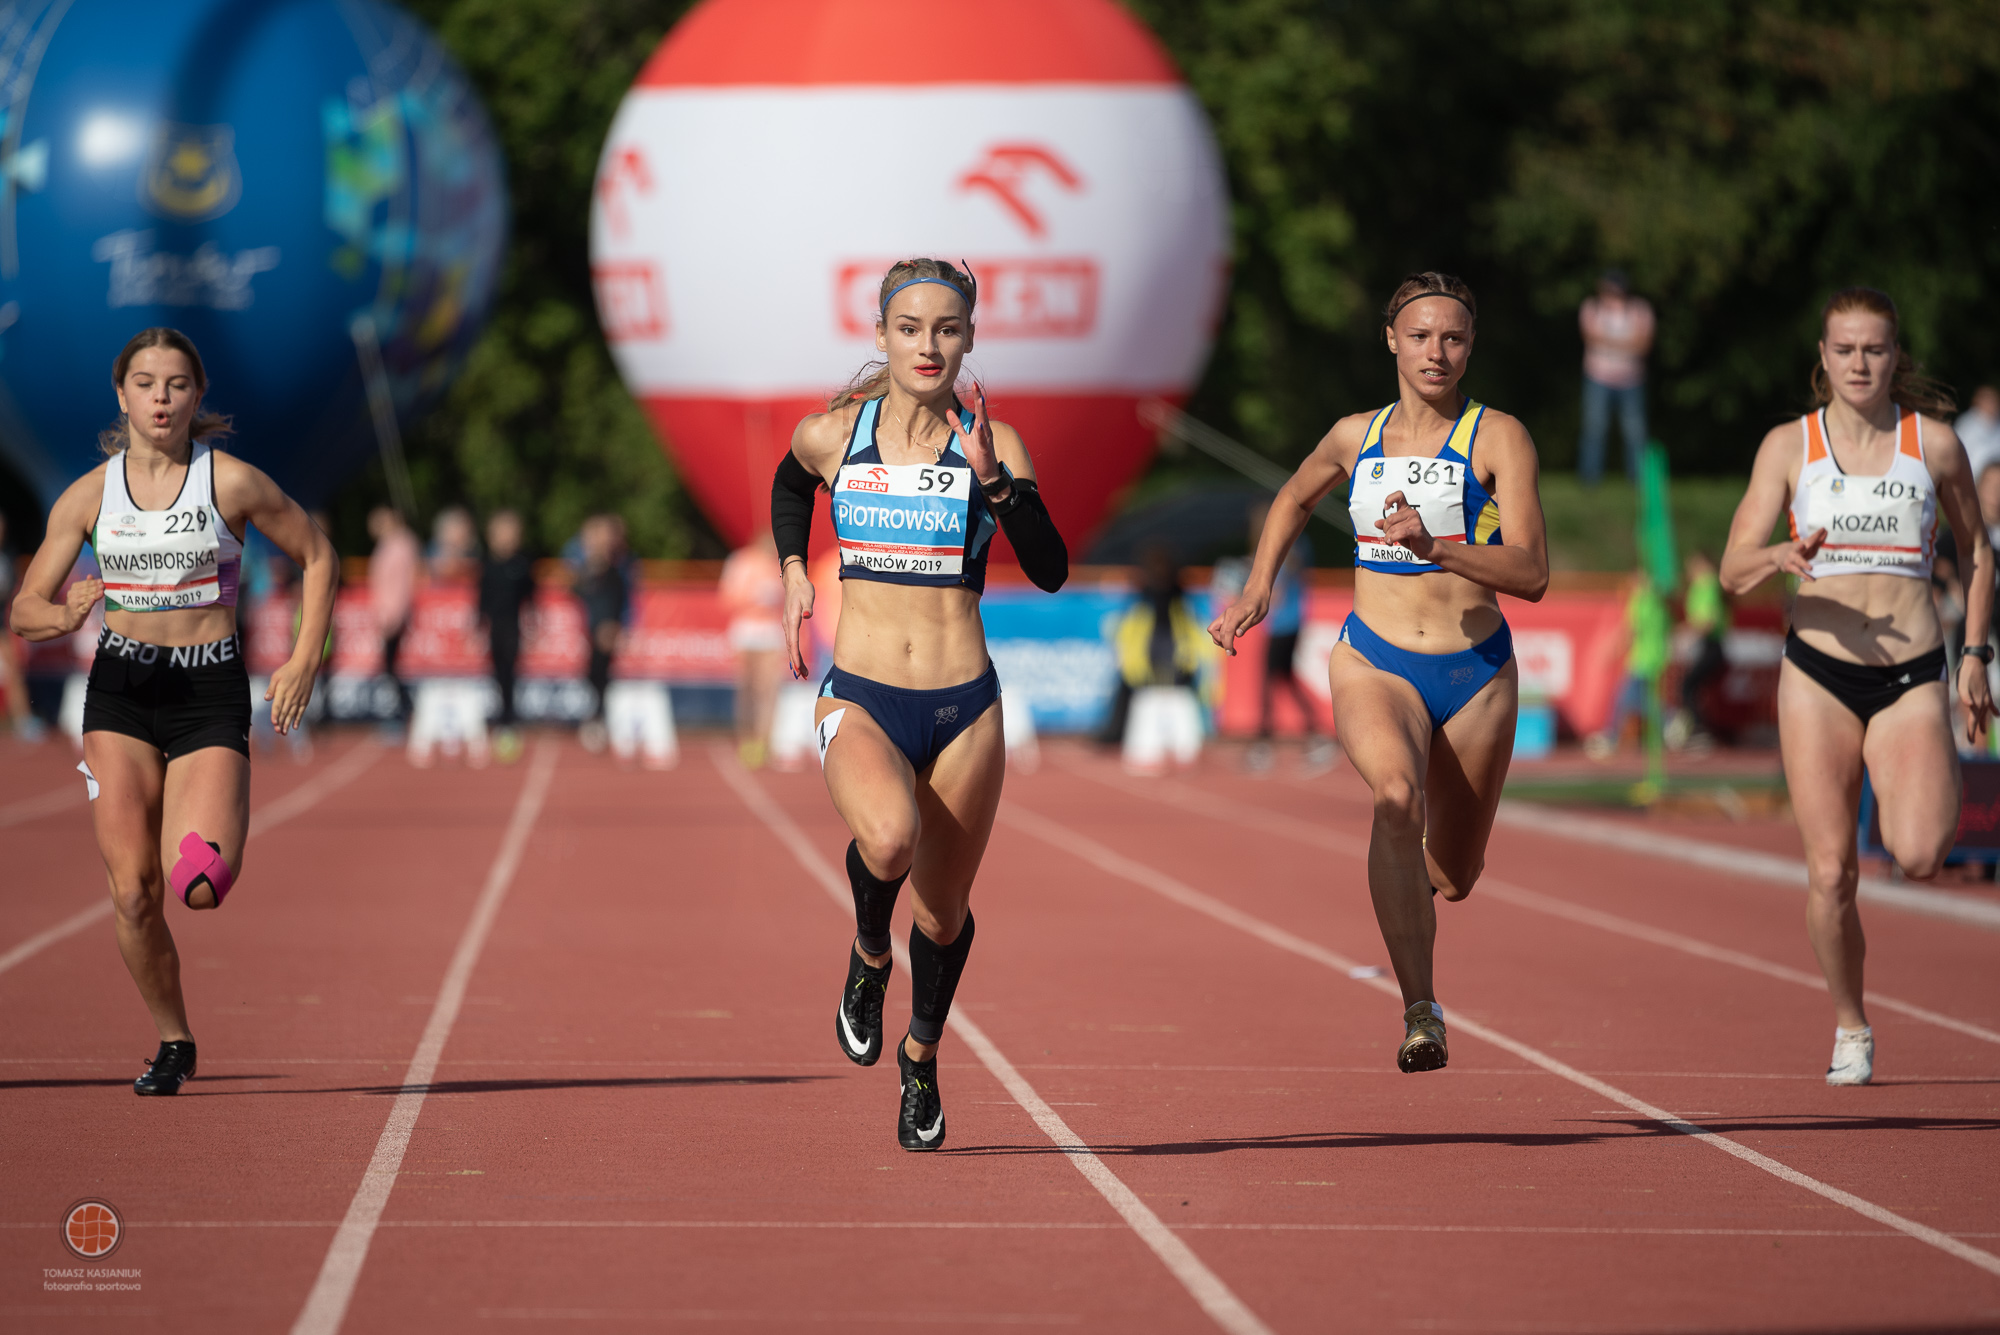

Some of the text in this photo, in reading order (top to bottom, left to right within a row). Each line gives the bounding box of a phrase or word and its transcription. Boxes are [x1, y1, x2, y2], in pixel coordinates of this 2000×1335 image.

[917, 468, 955, 493] 59
[1407, 460, 1457, 486] 361
[849, 480, 887, 492] ORLEN
[1872, 480, 1919, 501] 401
[164, 510, 208, 534] 229
[839, 504, 961, 533] PIOTROWSKA
[1832, 515, 1899, 534] KOZAR
[103, 550, 215, 571] KWASIBORSKA
[853, 554, 943, 572] TARNÓW 2019
[1370, 547, 1414, 561] TARNÓW
[1824, 551, 1875, 566] TARNÓW
[121, 590, 203, 607] TARNÓW 2019
[105, 632, 159, 664] PRO
[169, 640, 235, 668] NIKE
